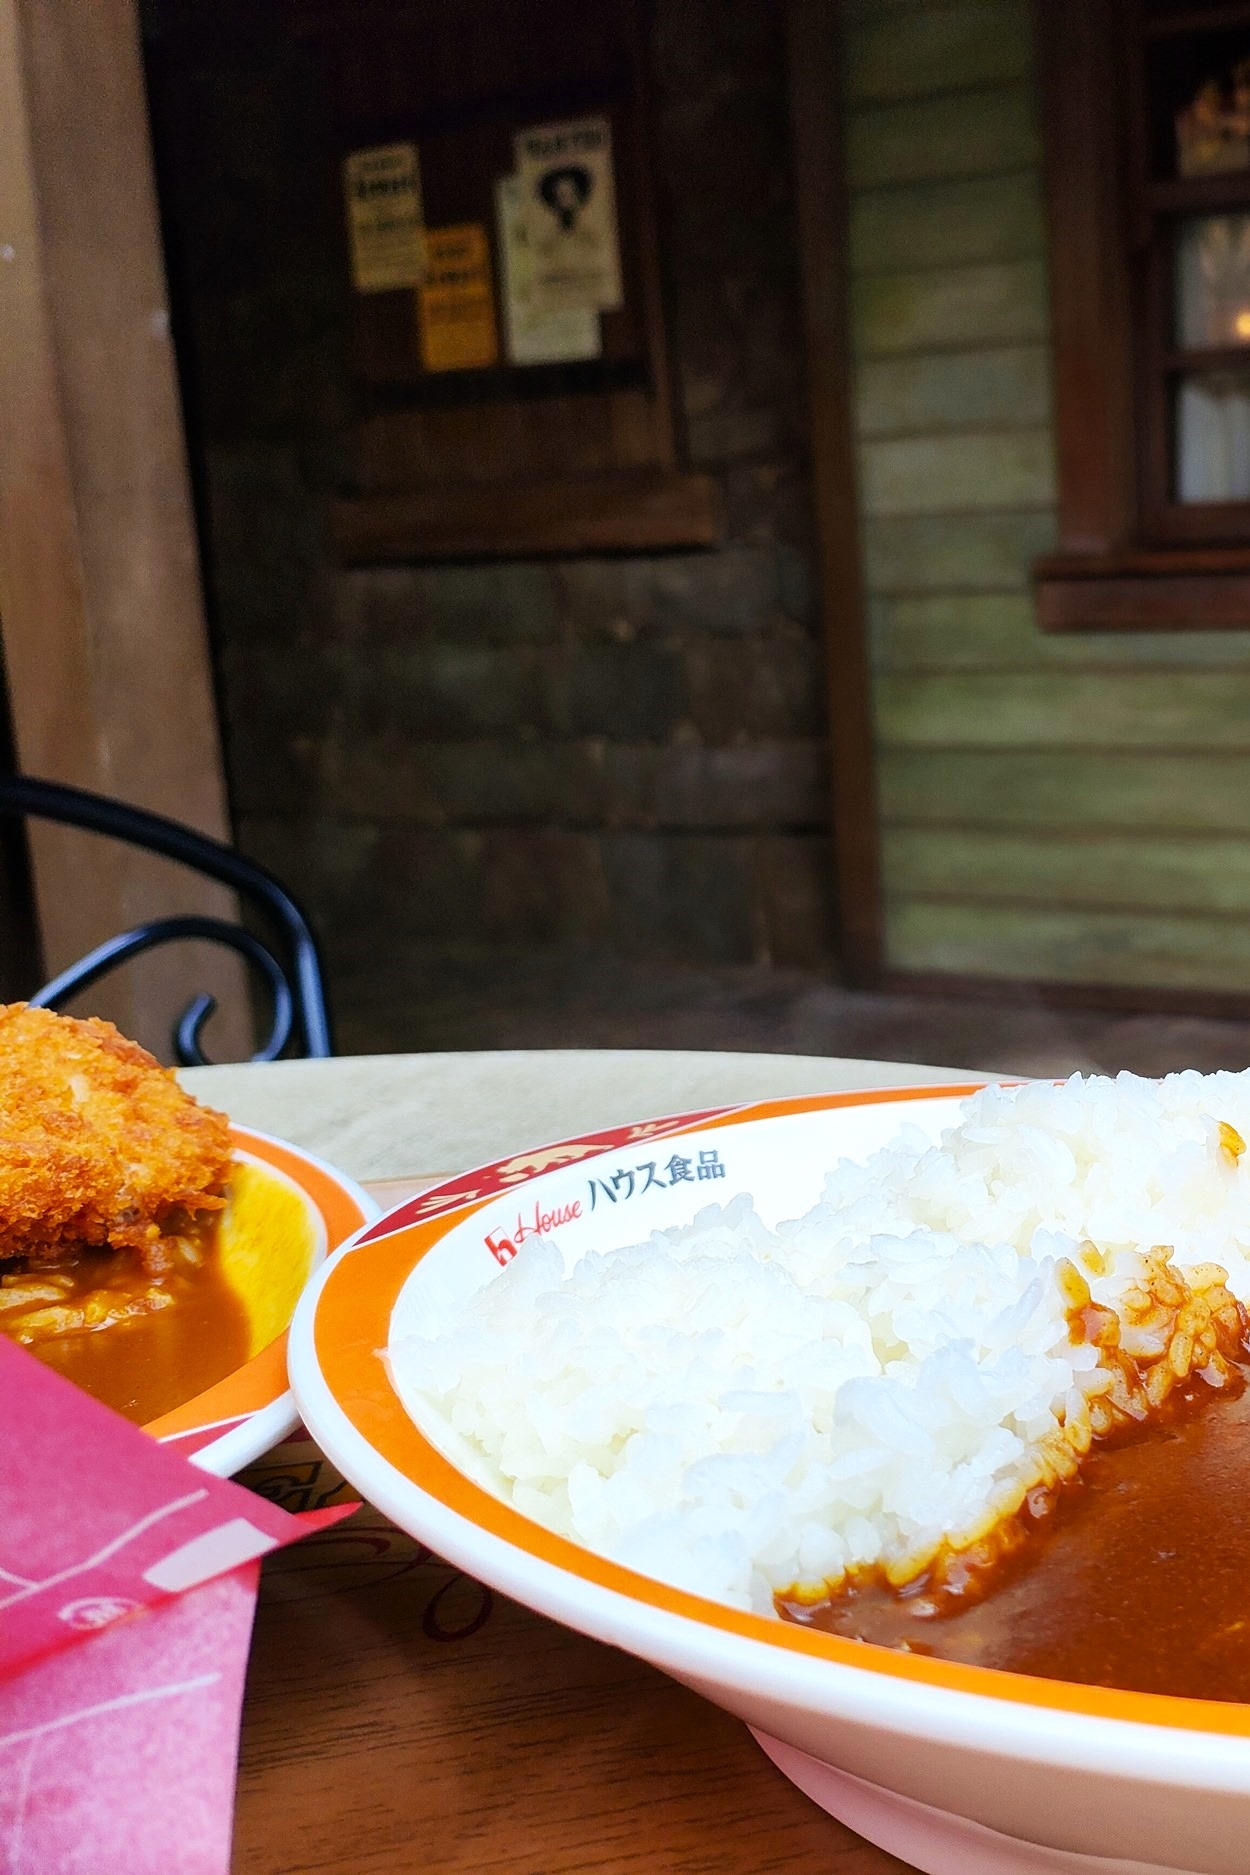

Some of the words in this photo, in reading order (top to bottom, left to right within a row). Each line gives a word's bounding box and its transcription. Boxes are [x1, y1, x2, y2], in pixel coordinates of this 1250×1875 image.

[513, 1200, 583, 1244] House
[587, 1149, 727, 1212] ハウス食品
